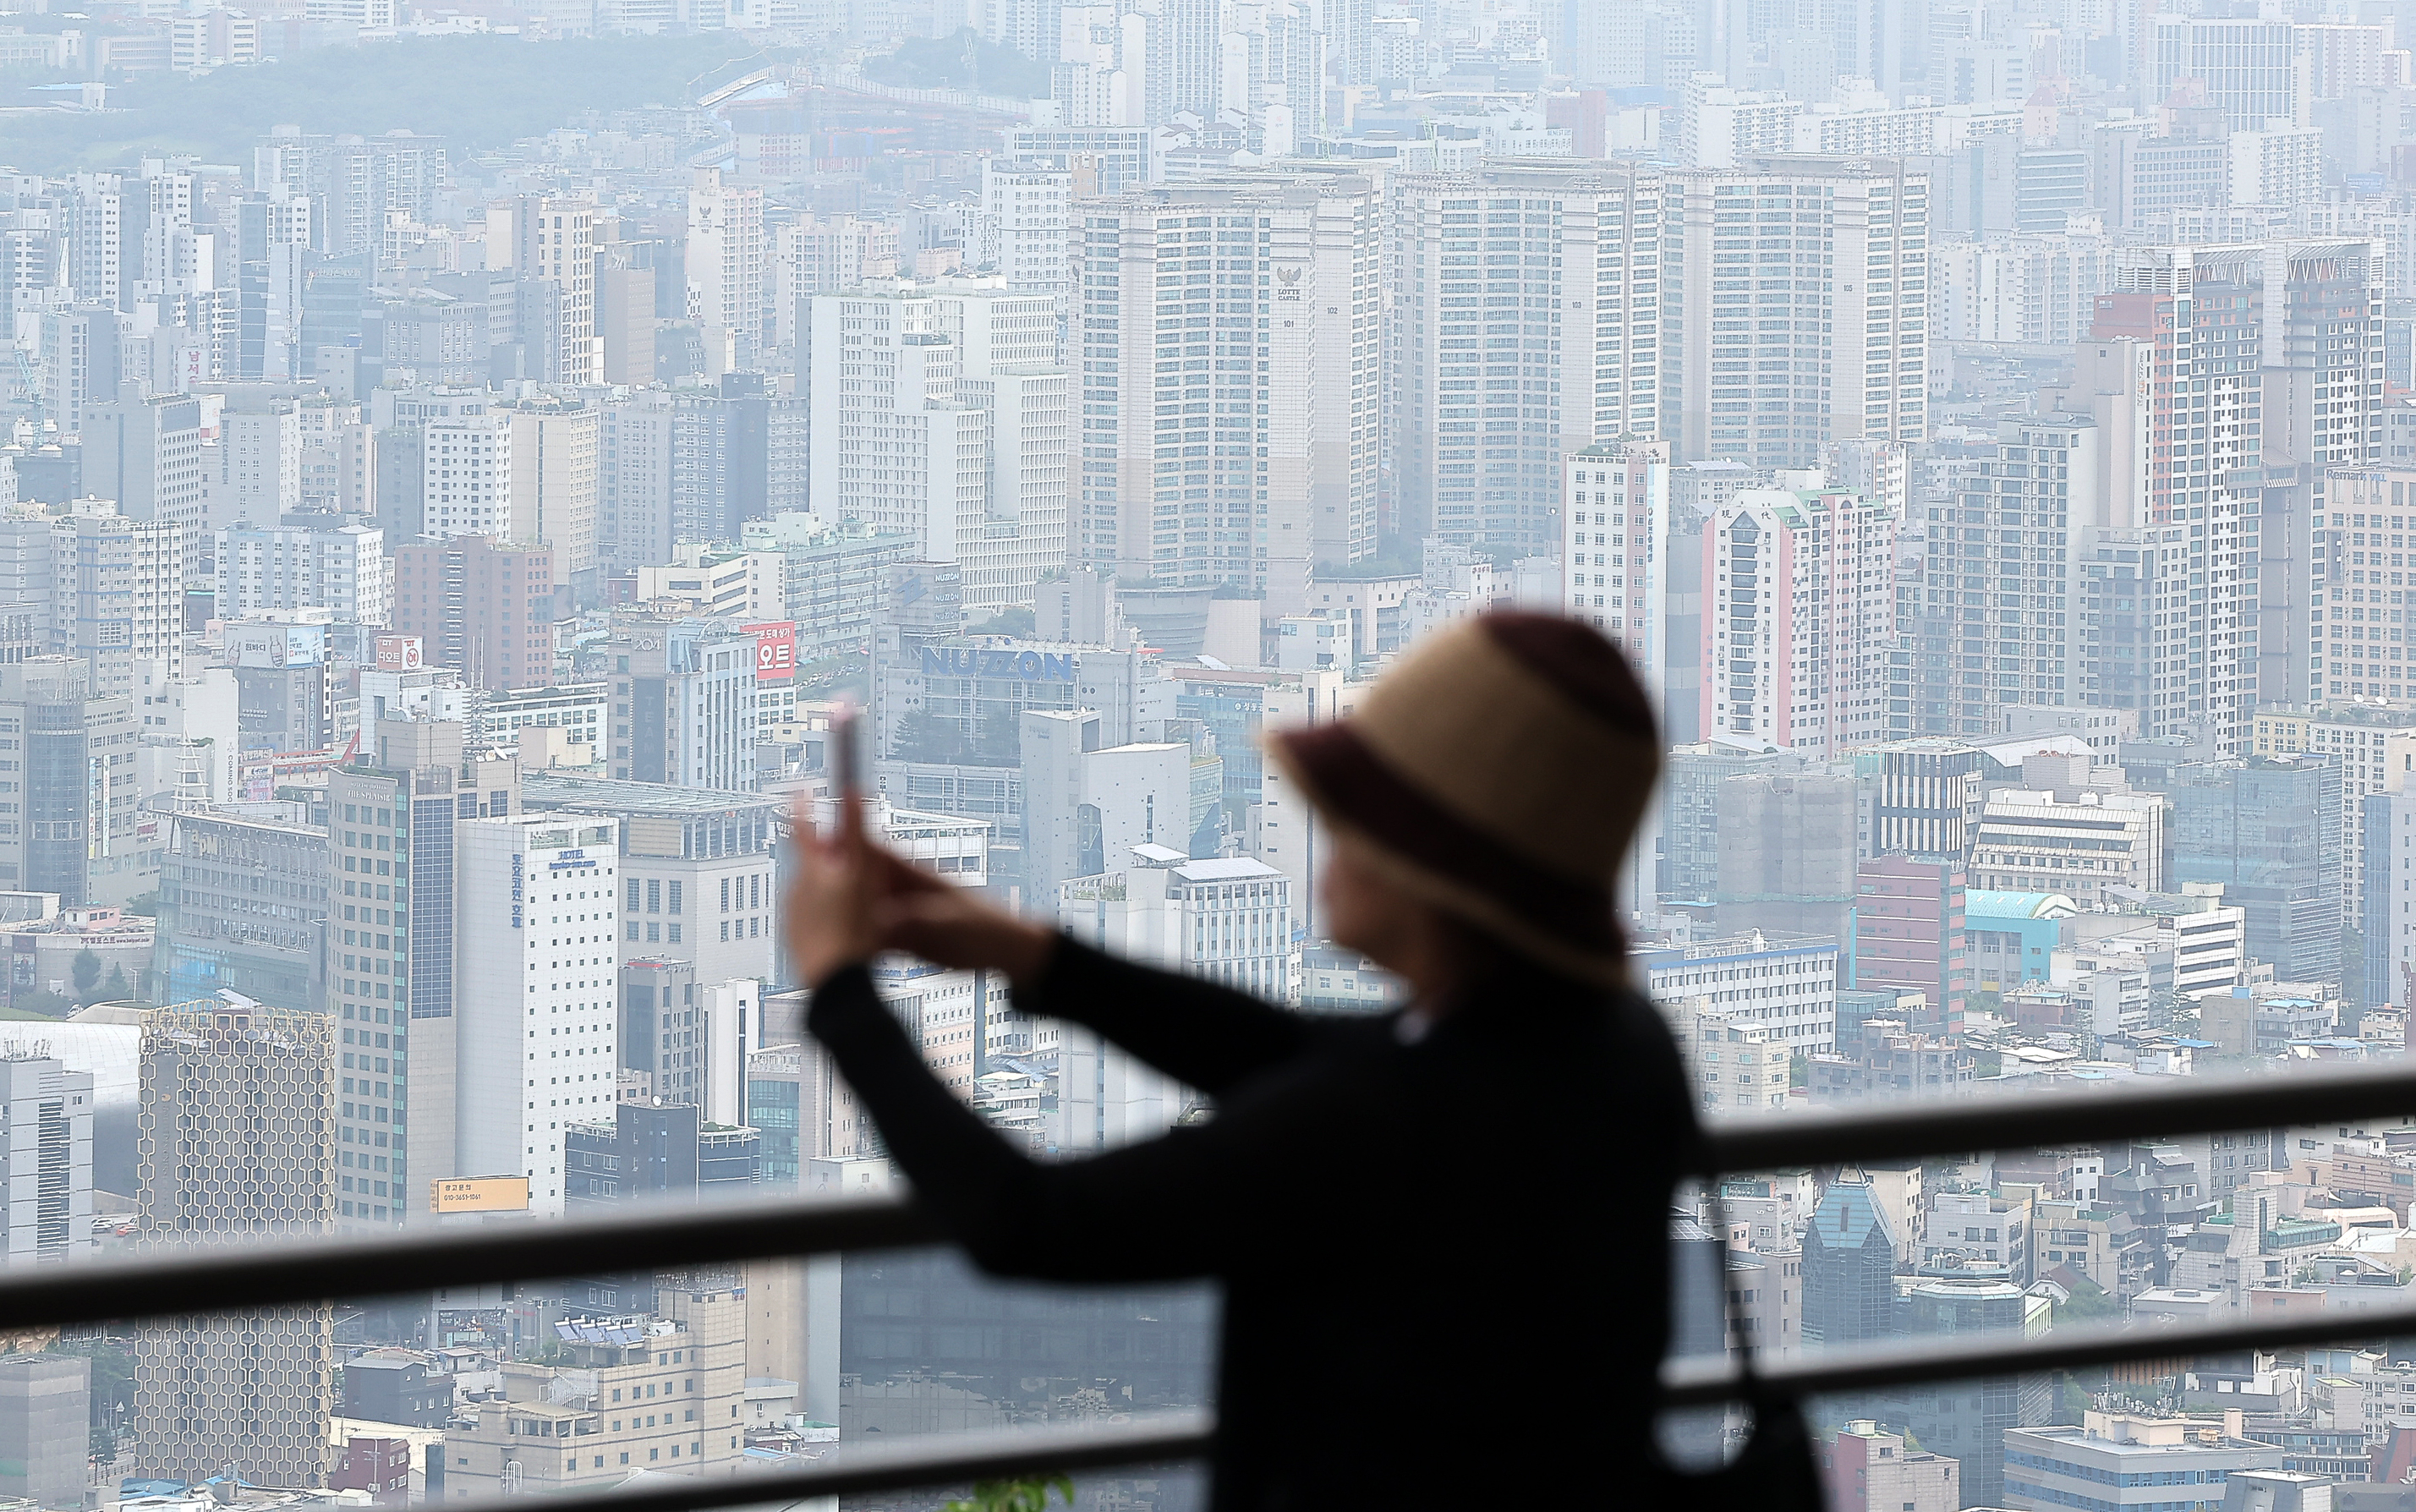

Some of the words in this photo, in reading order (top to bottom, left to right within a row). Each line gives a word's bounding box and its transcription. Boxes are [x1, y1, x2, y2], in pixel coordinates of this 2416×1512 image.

[1284, 320, 1294, 328] 101
[2326, 469, 2367, 481] Remark
[1722, 509, 1733, 518] 現
[1761, 511, 1772, 520] 代
[934, 573, 959, 583] NUZZON
[934, 594, 959, 603] NUZZON
[934, 613, 959, 622] NUZZON
[766, 628, 778, 639] 도매
[779, 627, 791, 638] 상가
[634, 638, 661, 652] 204
[759, 644, 791, 670] 오트
[922, 645, 1072, 682] NUZZON
[644, 695, 655, 753] TEAM
[347, 790, 360, 799] THE
[361, 792, 392, 803] SPLAISIR
[558, 849, 585, 861] HOTEL
[512, 853, 523, 901] 토요코인
